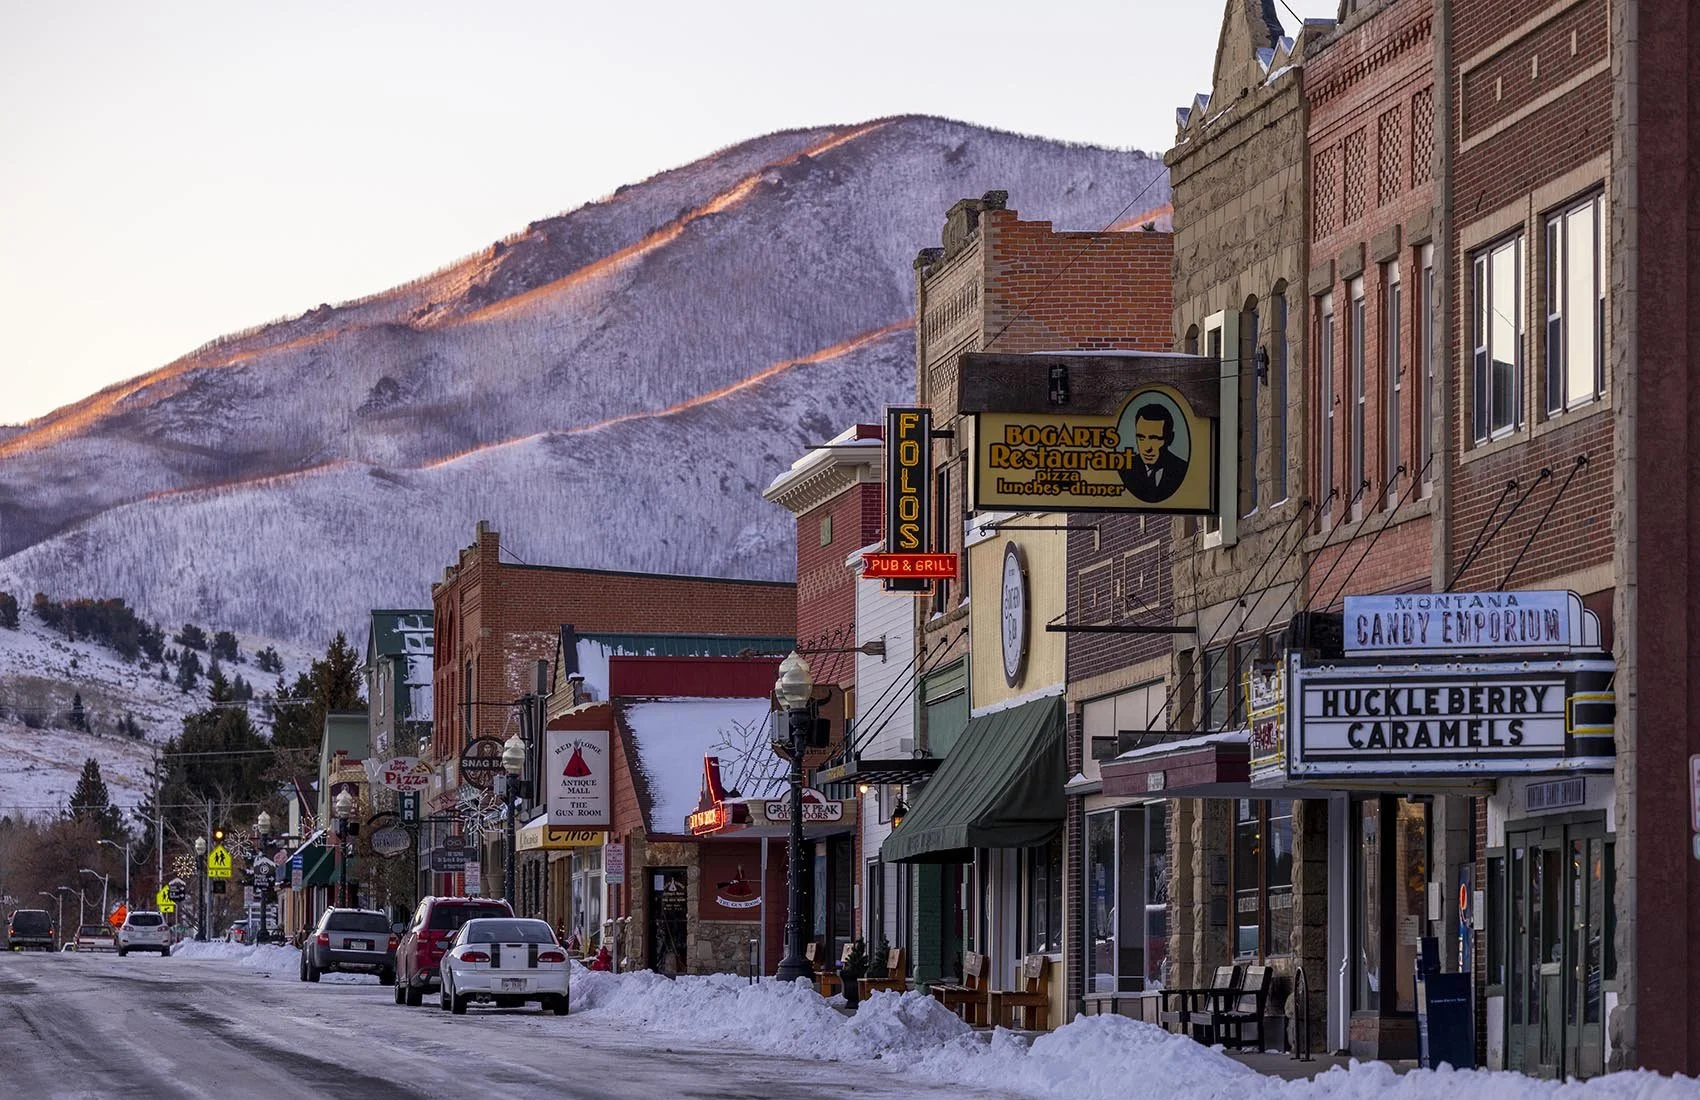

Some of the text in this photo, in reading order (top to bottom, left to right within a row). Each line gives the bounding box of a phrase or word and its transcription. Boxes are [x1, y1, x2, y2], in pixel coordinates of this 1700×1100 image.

[1005, 423, 1120, 448] BOGARTS
[989, 443, 1135, 471] Restaurant
[899, 413, 919, 549] FOLOS
[1036, 468, 1081, 483] pizza
[872, 559, 954, 571] PUB & GRILL
[1395, 594, 1519, 610] MONTANA
[1357, 608, 1560, 646] CANDY EMPORIUM
[1322, 685, 1549, 717] HUCKLEBERRY
[1348, 719, 1523, 749] CARAMELS
[555, 741, 602, 755] RED LODGE
[462, 759, 489, 767] SNAG
[384, 772, 428, 785] Pizza
[812, 804, 838, 815] PEAK
